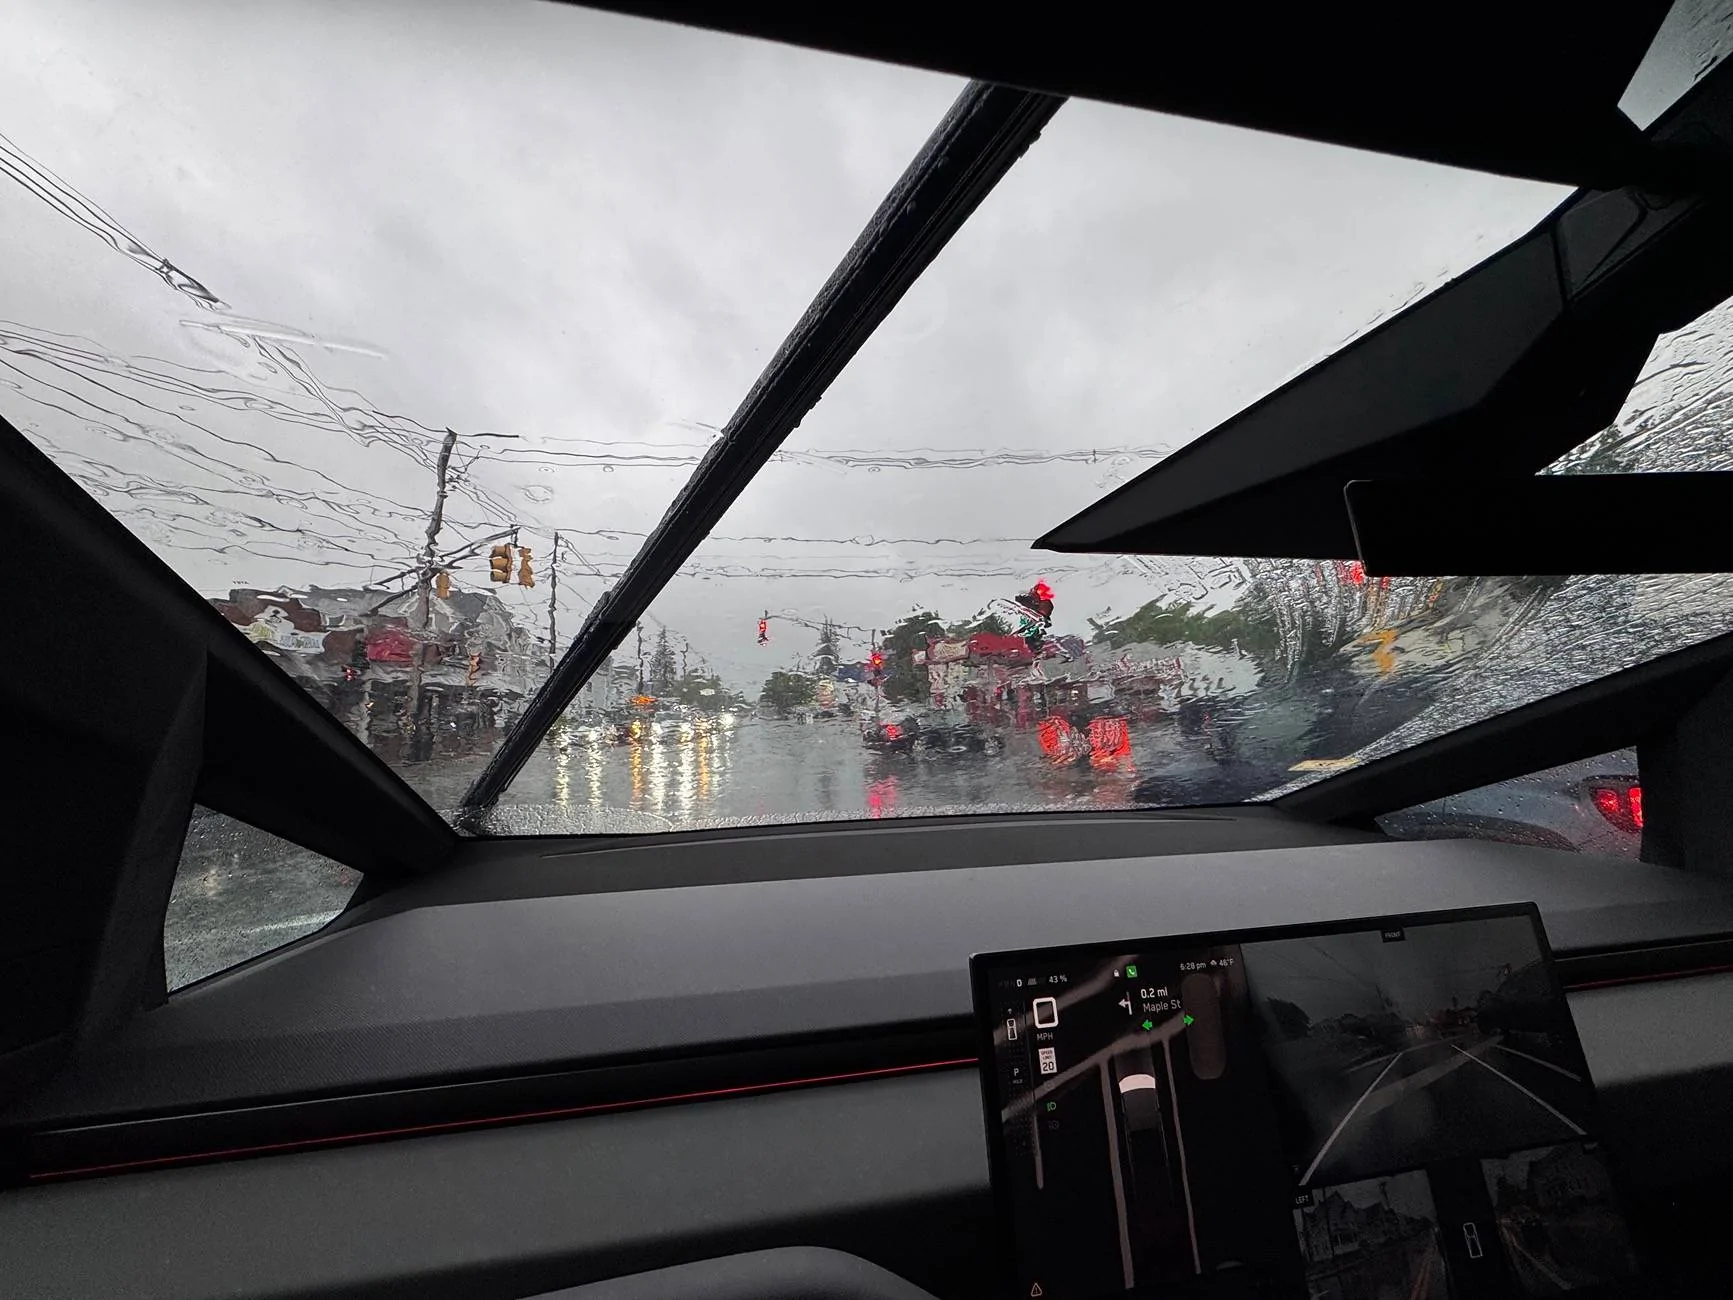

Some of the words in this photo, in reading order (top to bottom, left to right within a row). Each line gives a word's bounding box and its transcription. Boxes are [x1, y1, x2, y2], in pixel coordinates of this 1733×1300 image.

[1180, 962, 1195, 971] 6:28
[1196, 962, 1206, 970] pm
[1140, 988, 1155, 999] 0.2
[1157, 986, 1168, 997] mi
[1143, 1002, 1168, 1013] Maple
[1171, 999, 1181, 1010] St
[1036, 1032, 1054, 1041] MPH
[1042, 1061, 1055, 1071] 20
[1013, 1067, 1020, 1077] P
[1295, 1194, 1309, 1205] LEFT
